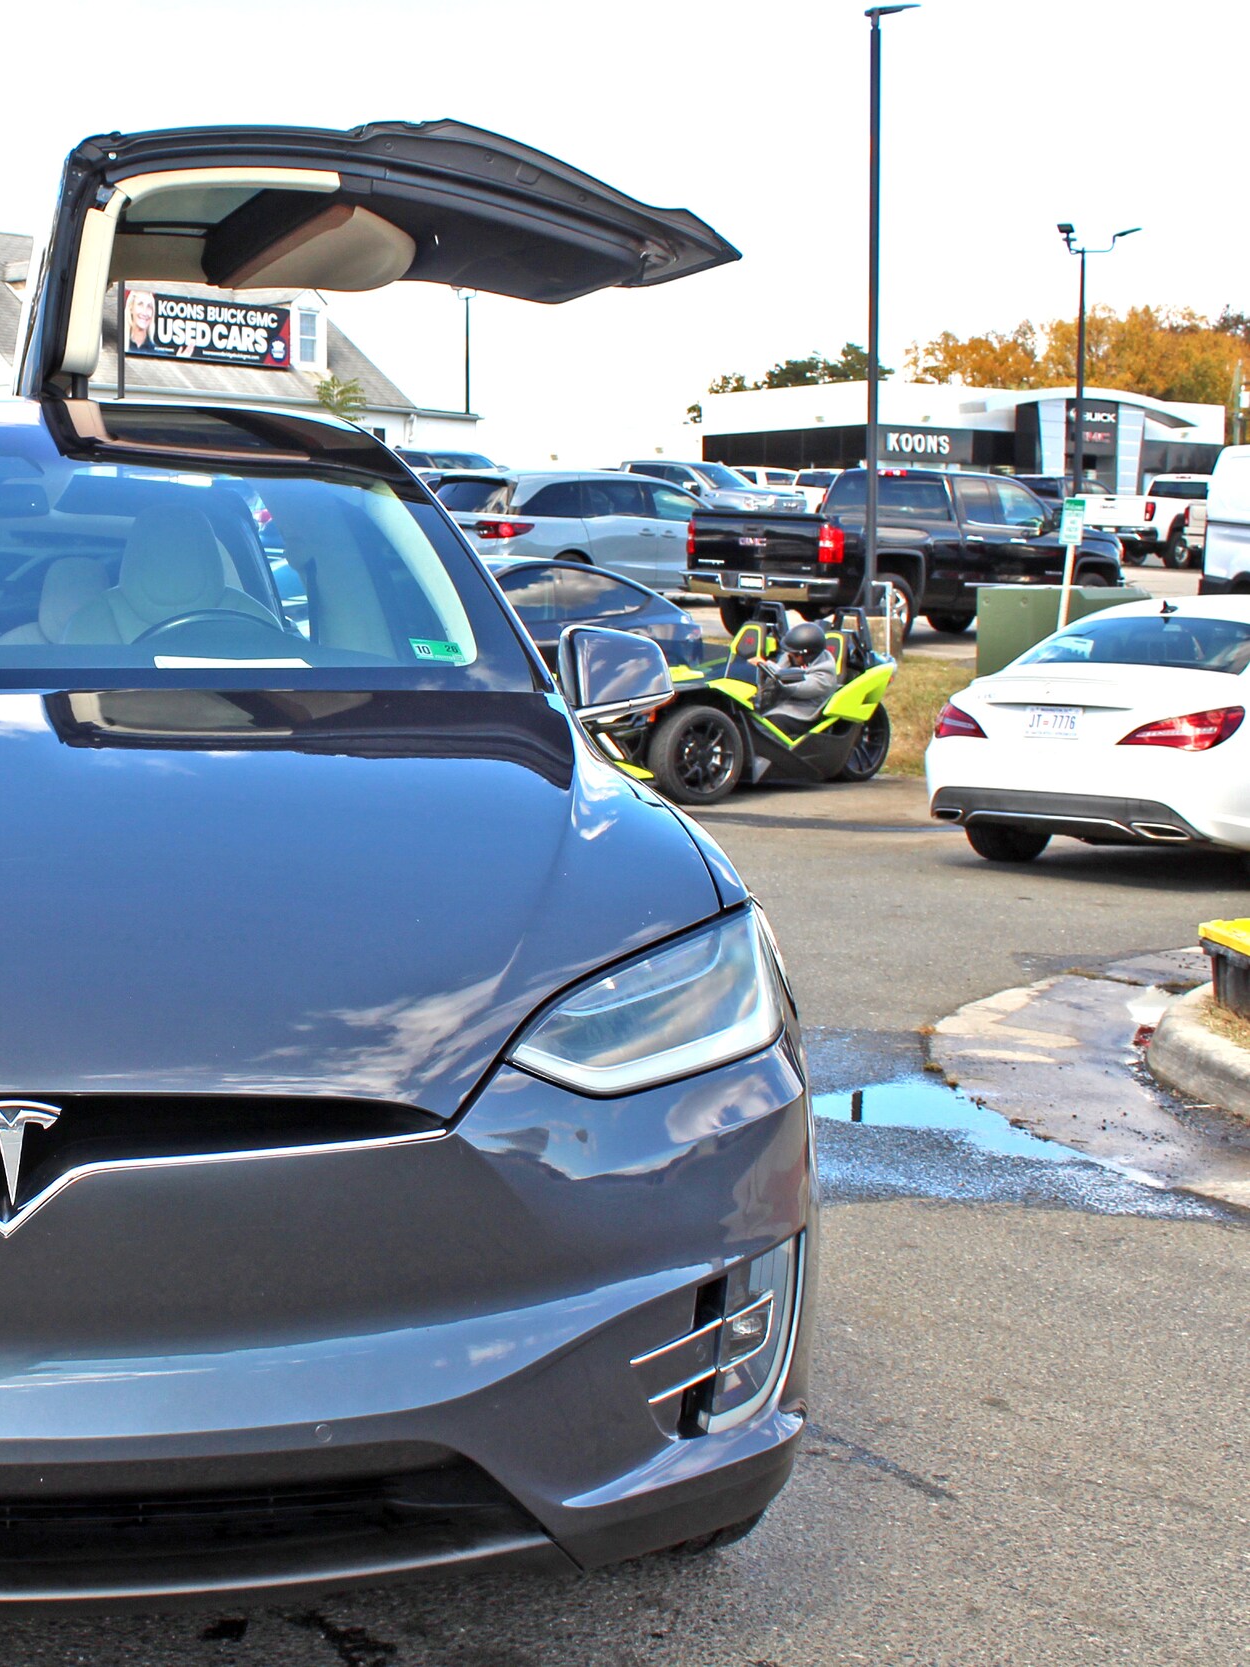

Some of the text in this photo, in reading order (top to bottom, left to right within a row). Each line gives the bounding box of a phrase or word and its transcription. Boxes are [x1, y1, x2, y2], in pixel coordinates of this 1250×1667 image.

[157, 300, 278, 329] KOONS BUICK GMC
[157, 317, 268, 354] USED CARS
[886, 432, 950, 455] KOONS
[738, 537, 767, 547] GMC
[415, 645, 431, 655] 10
[1028, 714, 1076, 730] JT 7776
